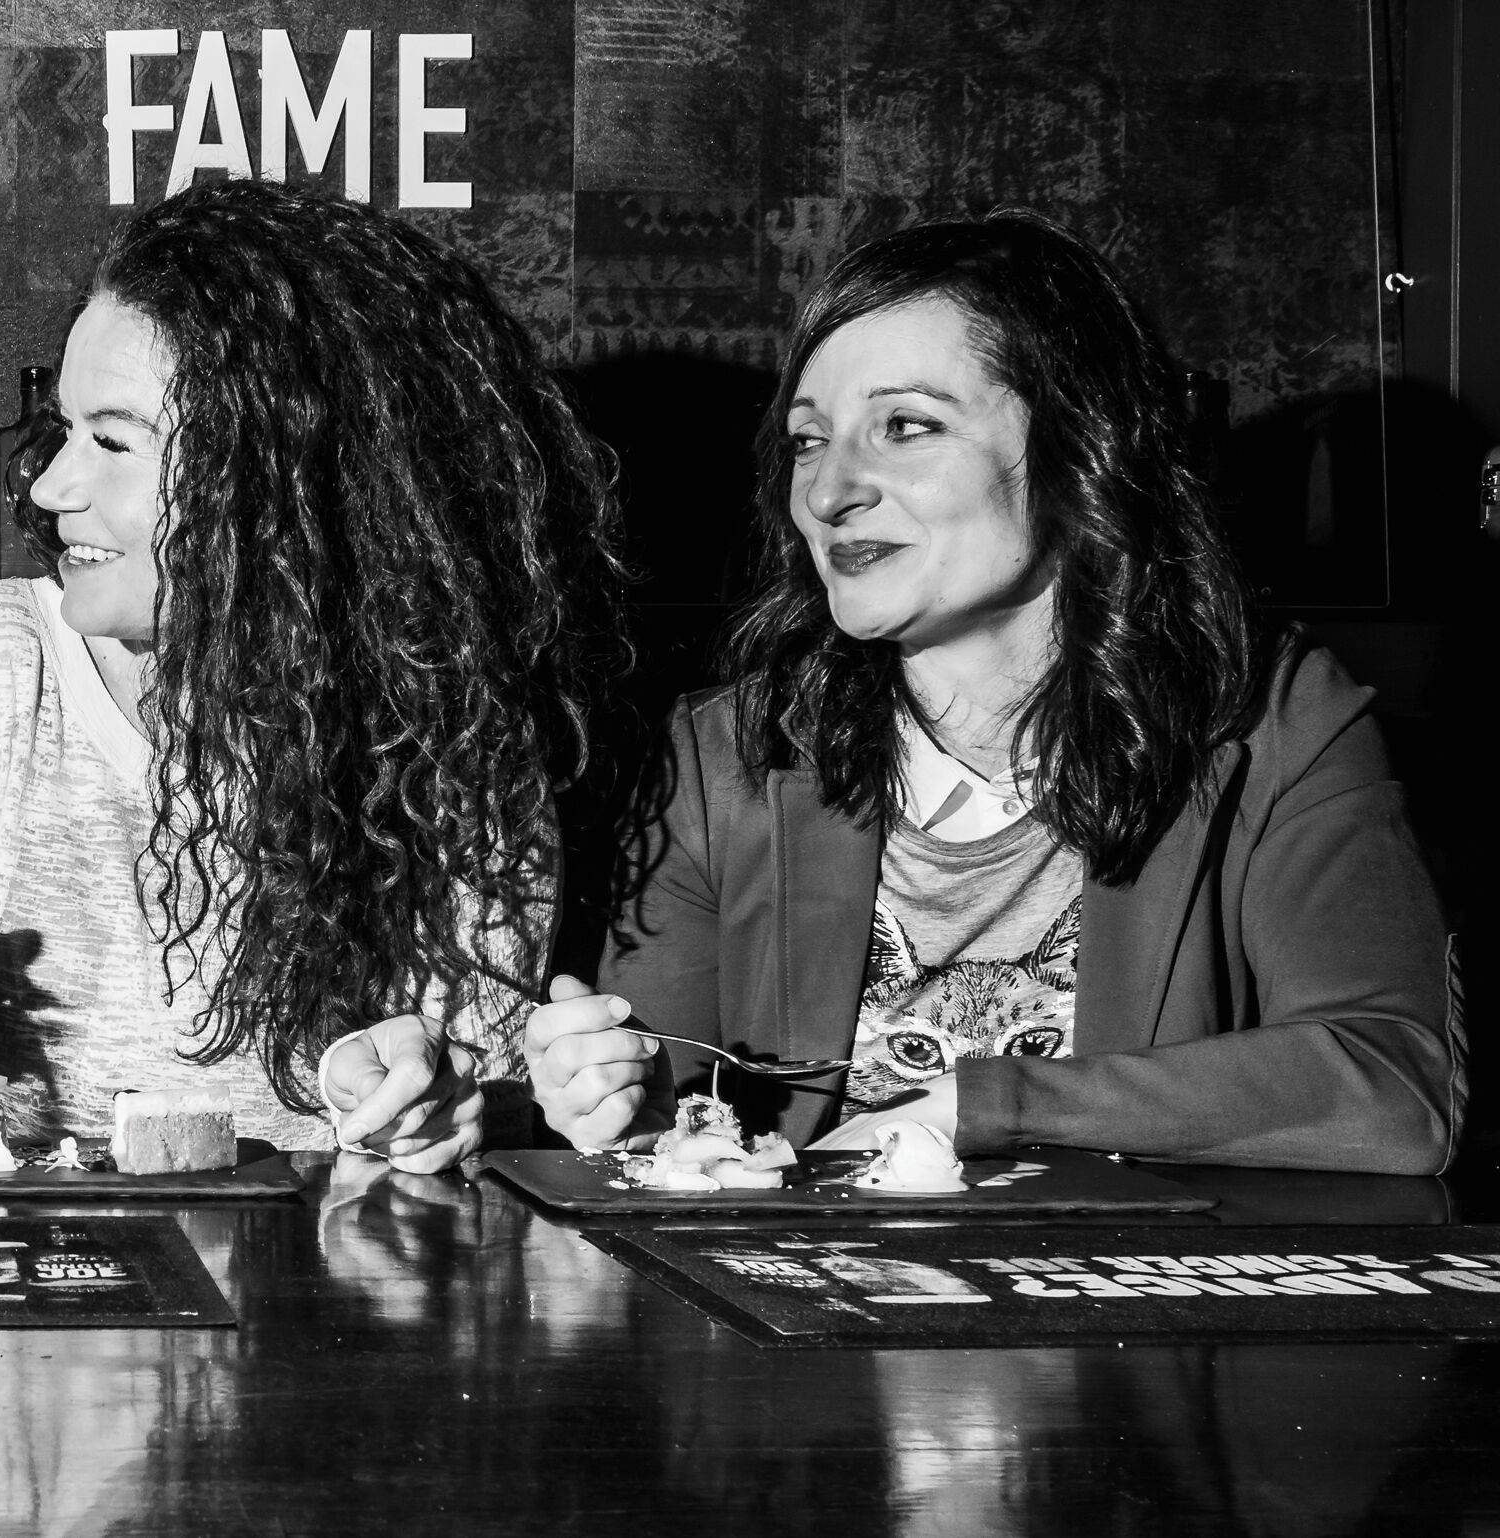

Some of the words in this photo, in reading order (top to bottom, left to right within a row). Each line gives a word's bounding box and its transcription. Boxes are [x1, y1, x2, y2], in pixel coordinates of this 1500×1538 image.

[102, 28, 474, 209] FAME
[36, 1267, 128, 1279] JOE
[949, 1257, 1090, 1273] JOE.
[1091, 1255, 1350, 1275] GINGER
[1009, 1271, 1433, 1298] ADVICE?
